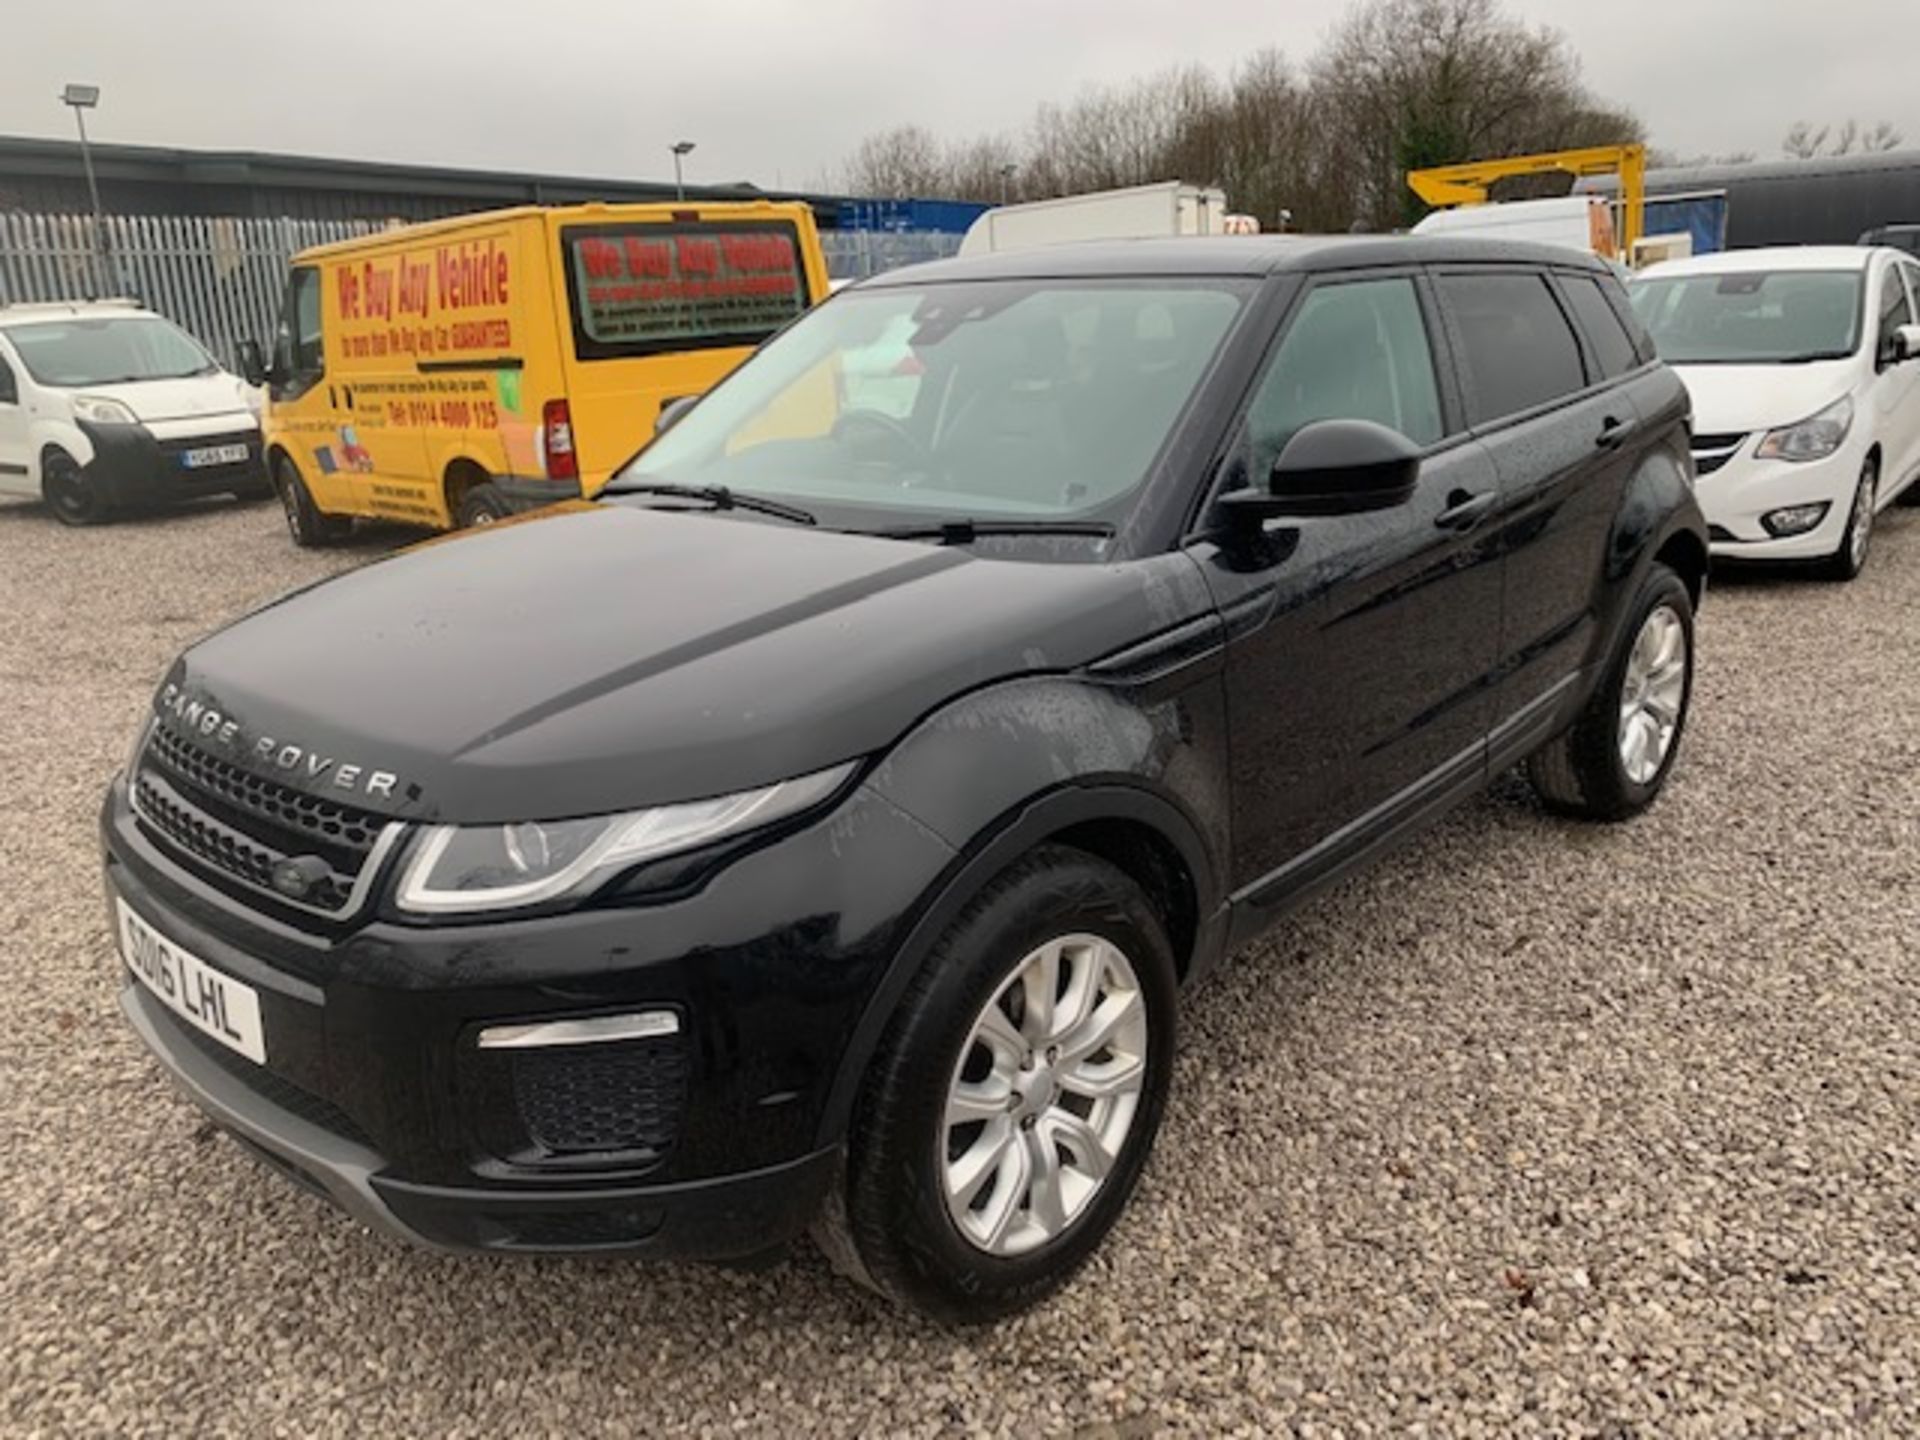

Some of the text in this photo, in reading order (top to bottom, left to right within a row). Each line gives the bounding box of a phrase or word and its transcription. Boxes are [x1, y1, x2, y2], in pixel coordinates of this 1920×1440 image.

[337, 240, 508, 322] We Buy Any Vehicle
[580, 236, 623, 279] We
[162, 683, 397, 798] RANGE ROVER
[178, 956, 243, 1042] LHL
